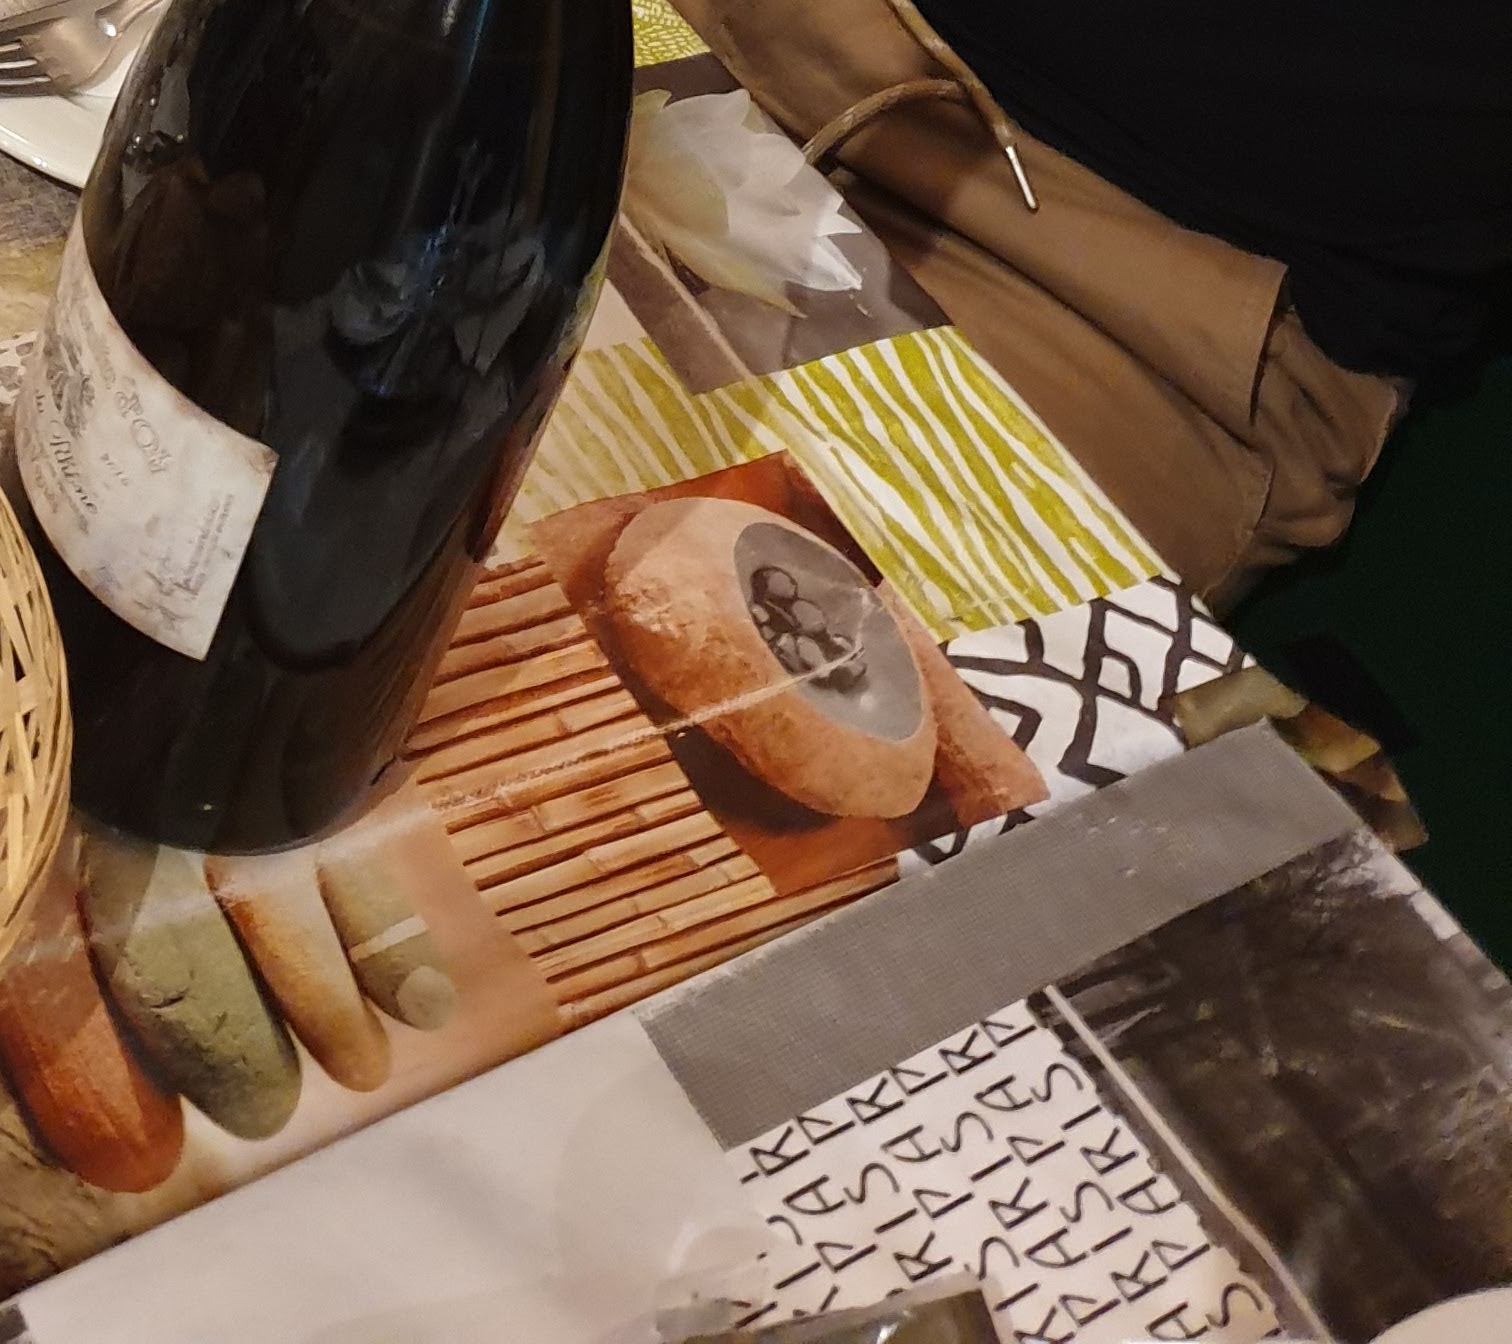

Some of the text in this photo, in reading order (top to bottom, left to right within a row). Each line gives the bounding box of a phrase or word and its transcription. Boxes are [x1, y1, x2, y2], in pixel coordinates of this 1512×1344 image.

[940, 1111, 1120, 1326] PARIS
[1031, 1062, 1210, 1271] PARIS
[1061, 1182, 1208, 1341] ARIS
